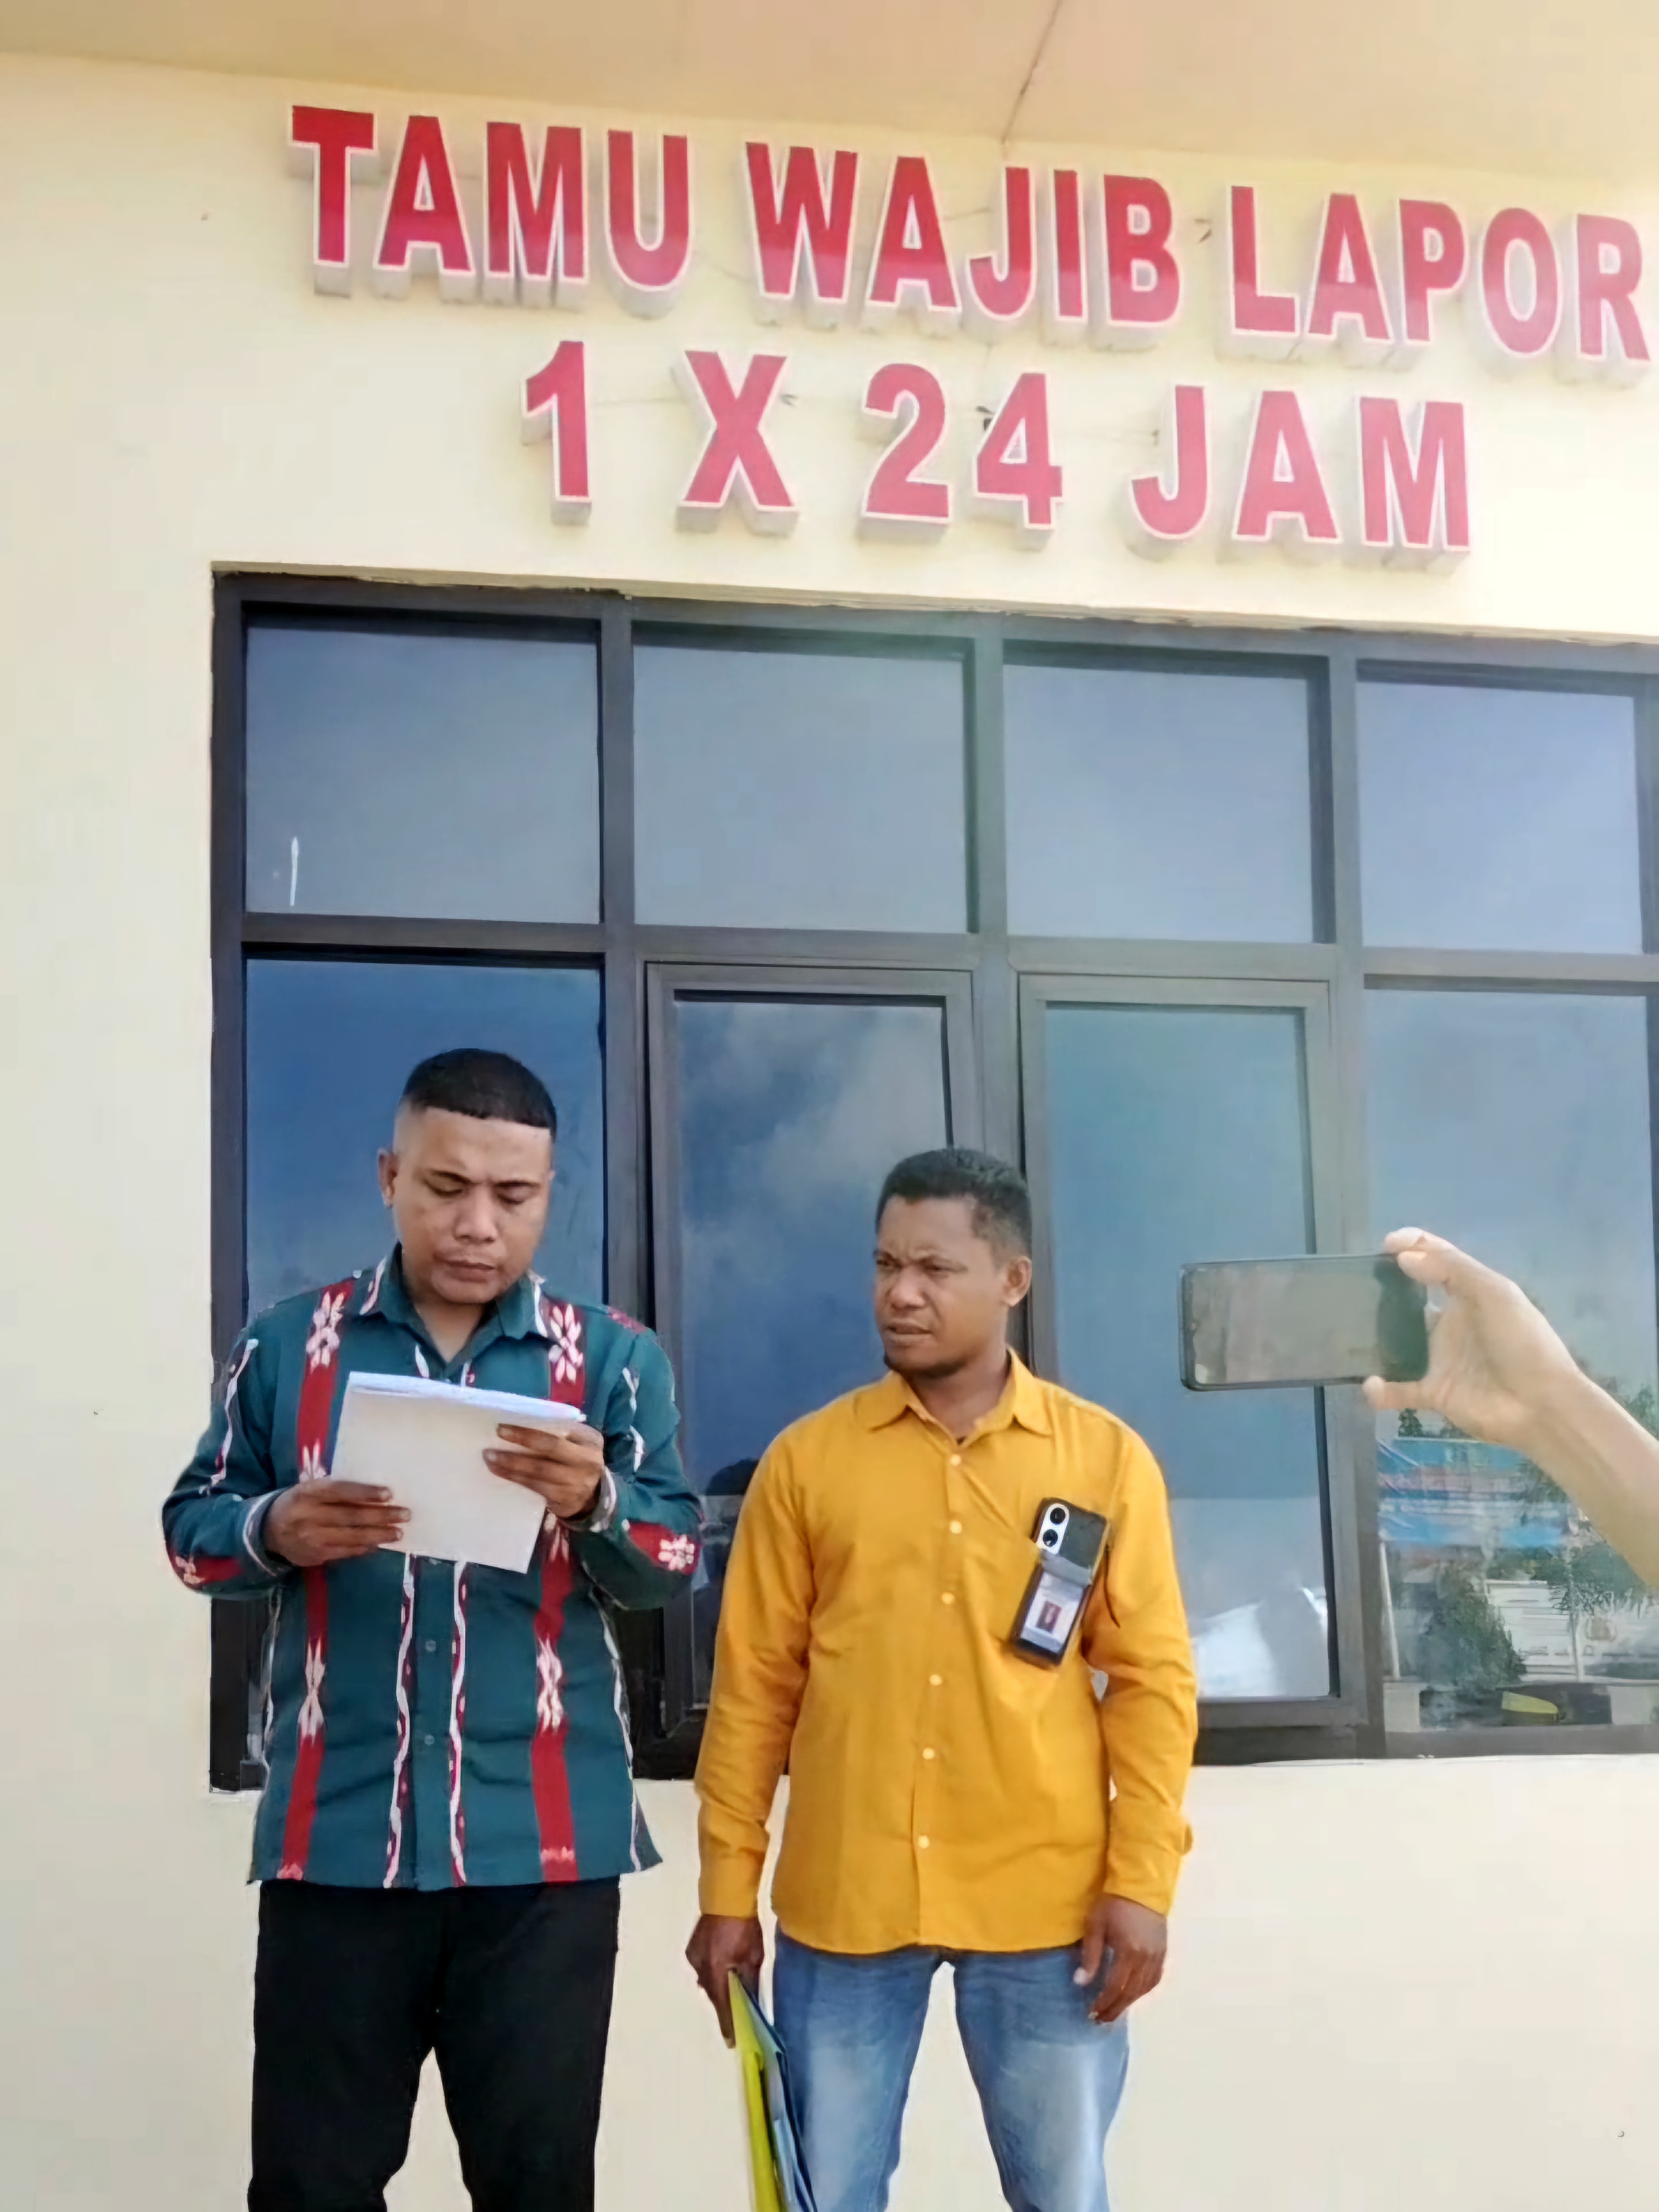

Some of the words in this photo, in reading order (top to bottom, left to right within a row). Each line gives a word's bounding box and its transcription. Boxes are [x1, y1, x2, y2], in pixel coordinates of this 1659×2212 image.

[290, 105, 693, 292] TAMU
[742, 142, 1181, 327] WAJIB
[1229, 185, 1652, 363] LAPOR
[521, 340, 592, 503] 1
[679, 349, 797, 512] X
[861, 362, 1064, 531] 24
[1129, 384, 1472, 551] JAM
